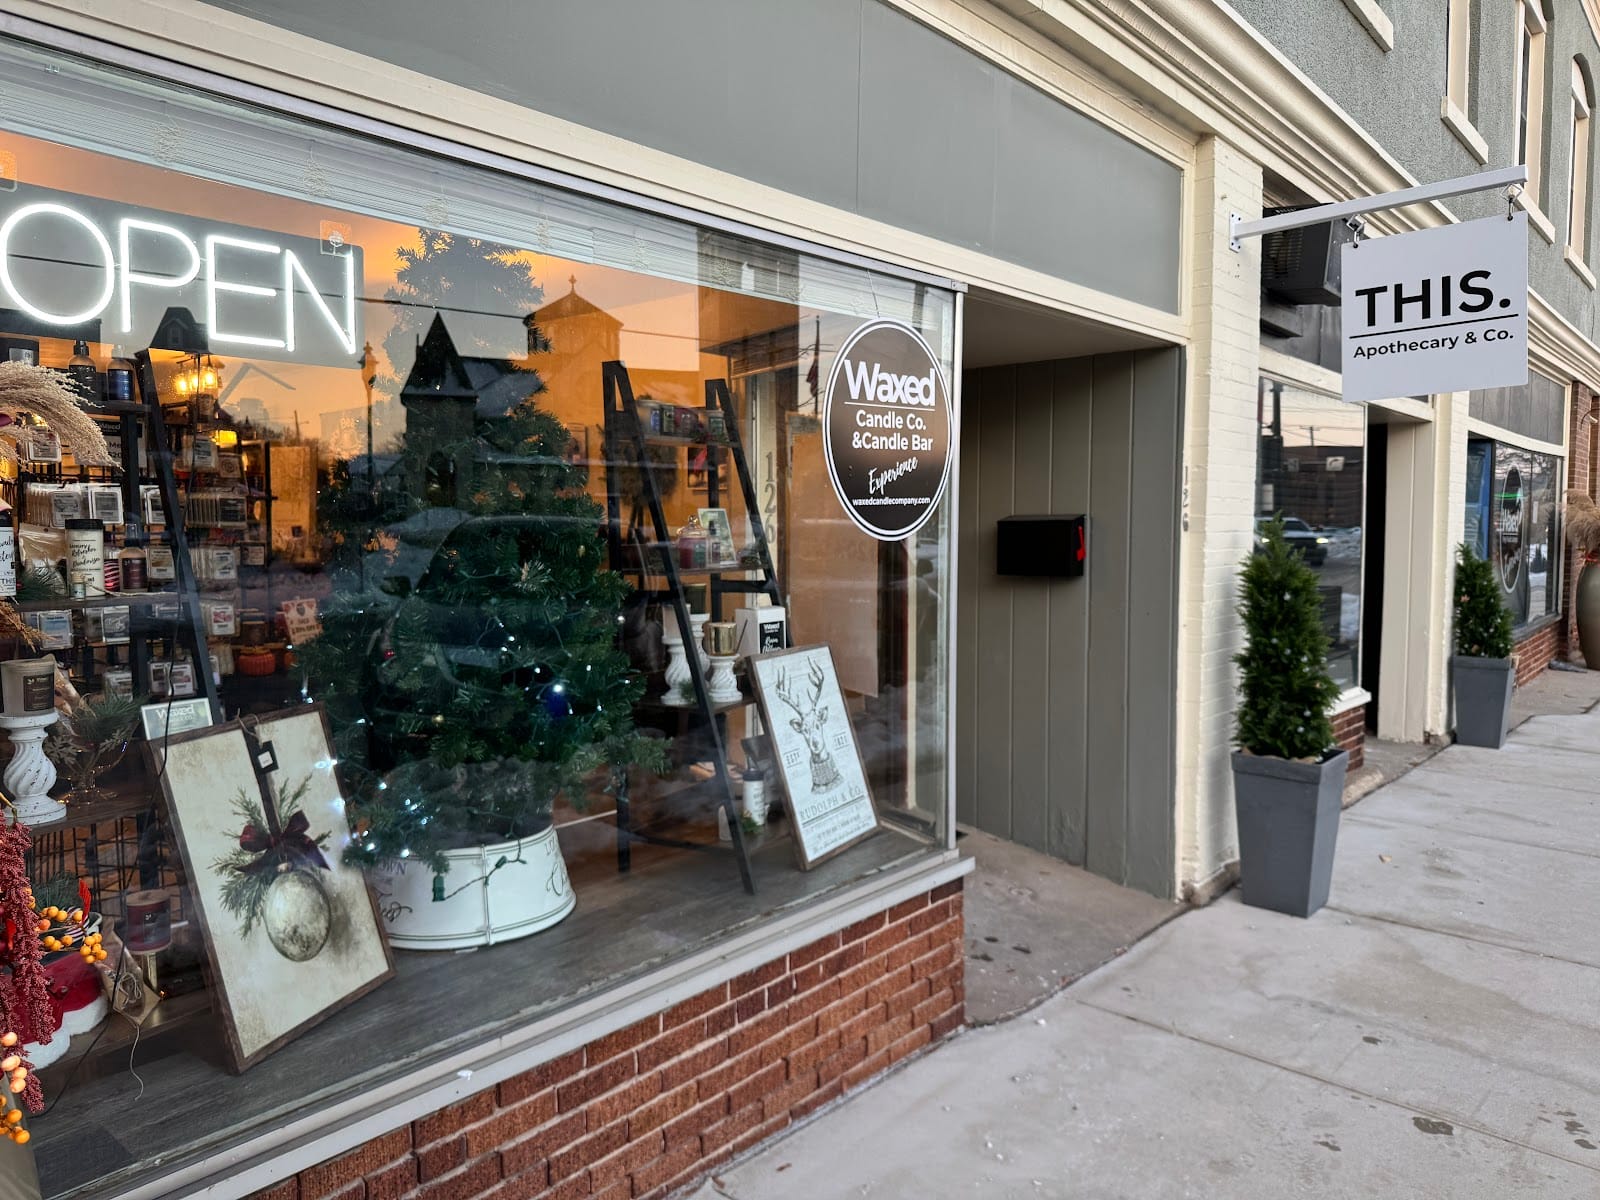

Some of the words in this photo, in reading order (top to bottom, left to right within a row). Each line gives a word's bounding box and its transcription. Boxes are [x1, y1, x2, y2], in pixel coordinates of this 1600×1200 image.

[0, 203, 357, 355] OPEN
[1355, 269, 1511, 327] THIS.
[1353, 335, 1460, 360] Apothecary
[1464, 331, 1477, 344] &
[1484, 328, 1514, 342] Co.
[844, 359, 936, 407] Waxed
[856, 410, 904, 430] Candle
[906, 413, 927, 431] Co.
[852, 432, 908, 451] &Candle
[912, 434, 933, 451] Bar
[868, 456, 919, 495] Experience
[852, 496, 931, 507] waxedcandlecompany.com
